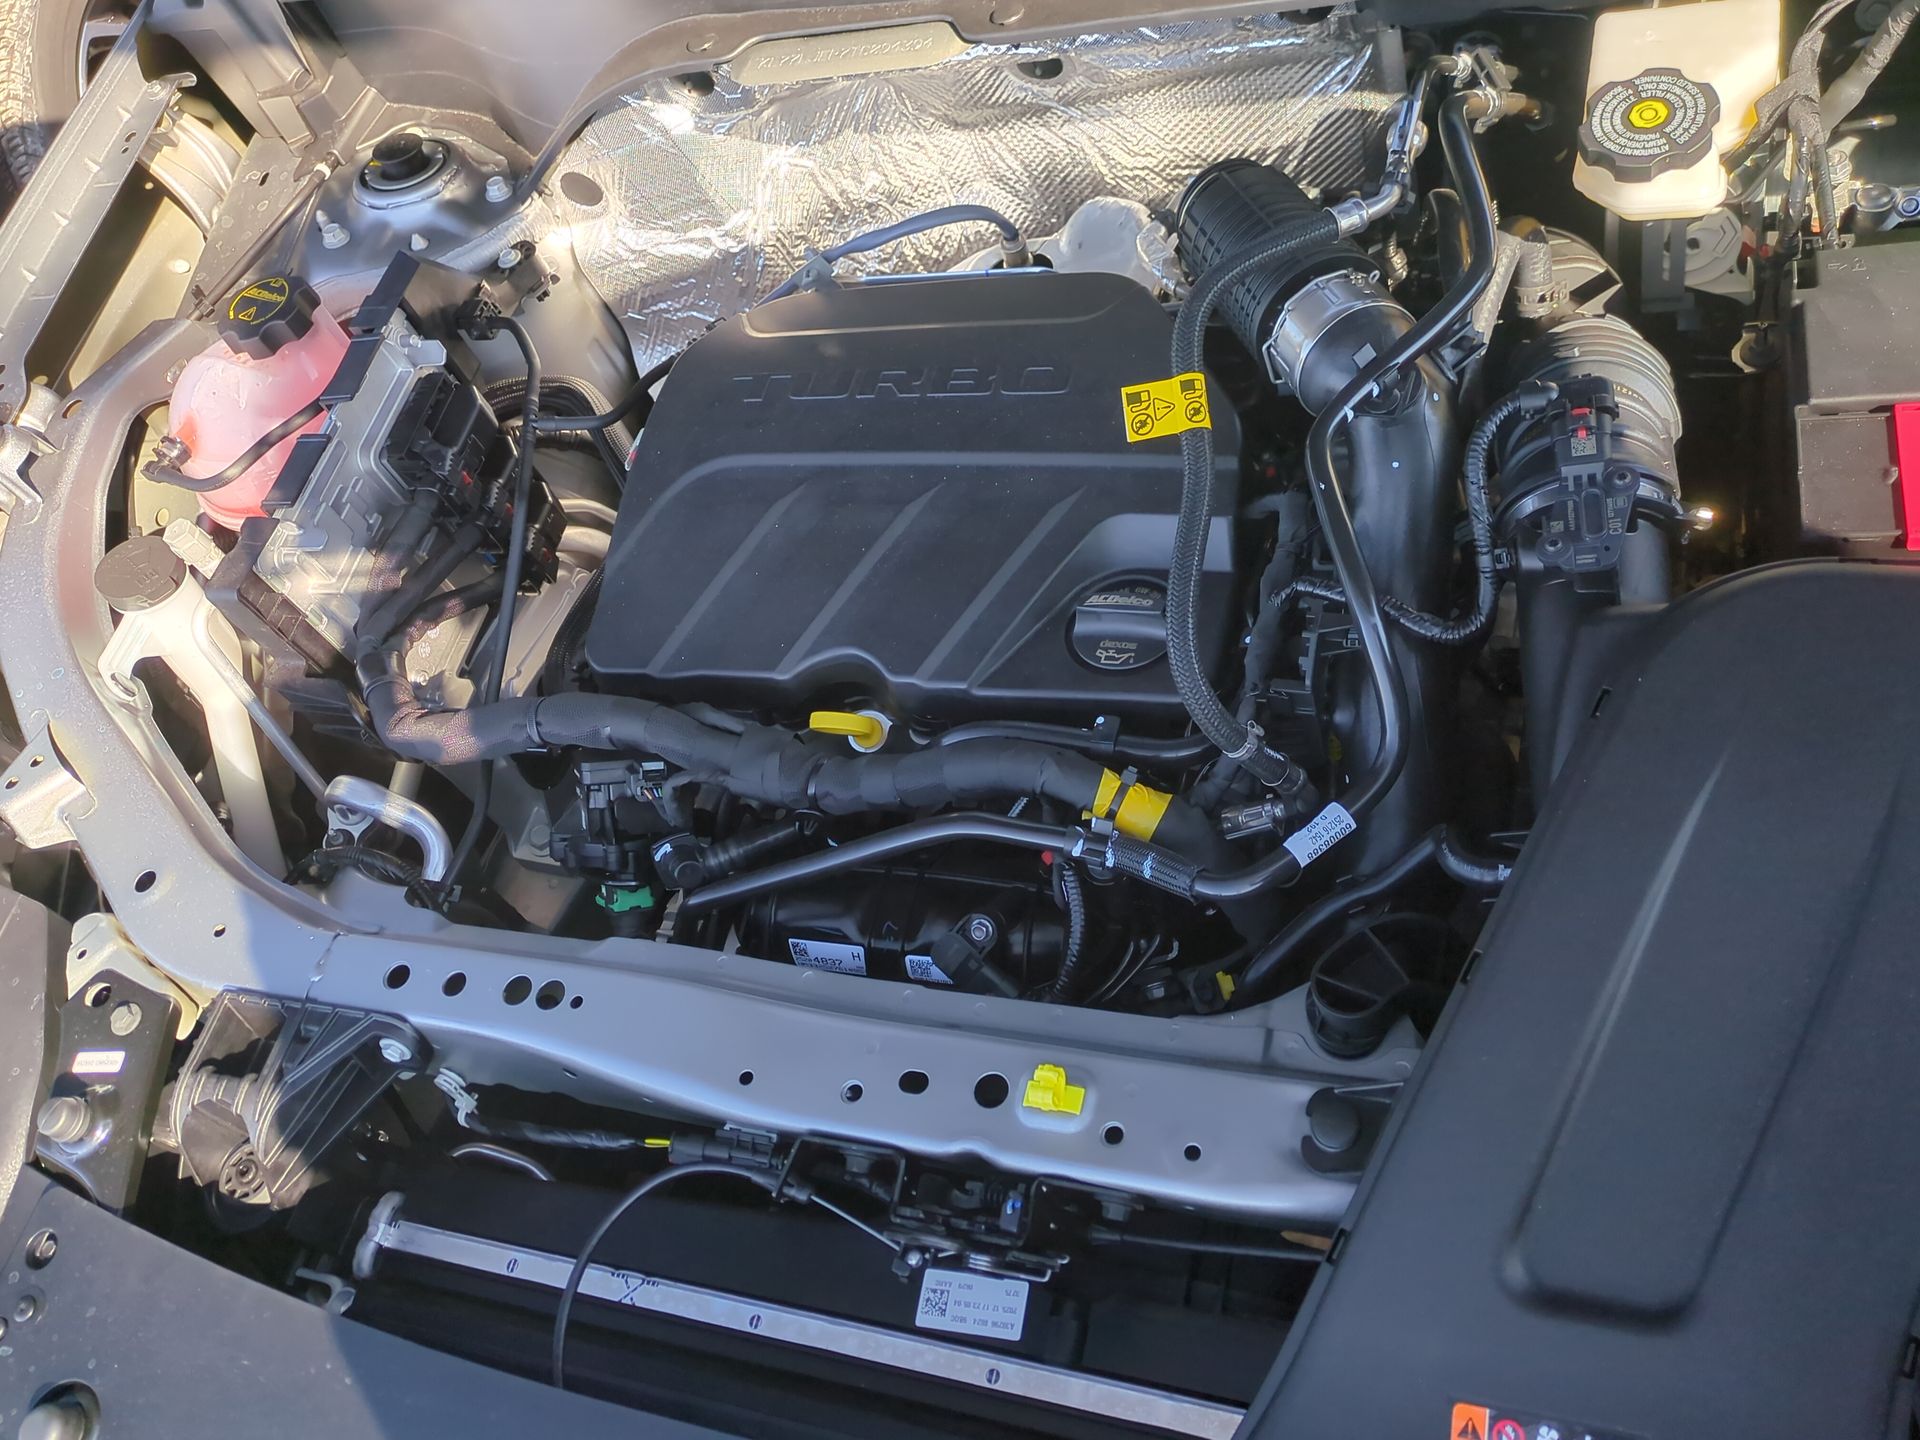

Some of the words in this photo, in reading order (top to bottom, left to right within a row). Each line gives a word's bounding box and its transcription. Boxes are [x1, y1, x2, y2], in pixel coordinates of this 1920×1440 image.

[1636, 83, 1657, 92] ONLY
[1674, 79, 1699, 95] SEALED
[1640, 91, 1666, 99] FILLER
[1663, 93, 1684, 108] CLEAN
[1694, 96, 1707, 113] FROM
[1680, 106, 1696, 128] BEFORE
[1690, 113, 1707, 131] FLUID
[1669, 127, 1686, 140] CAP
[732, 366, 1071, 403] TURBO
[1083, 594, 1153, 606] ACDelco
[1099, 640, 1138, 649] dexos
[1308, 830, 1324, 846] 1542
[813, 957, 843, 966] 4837
[851, 951, 862, 961] H
